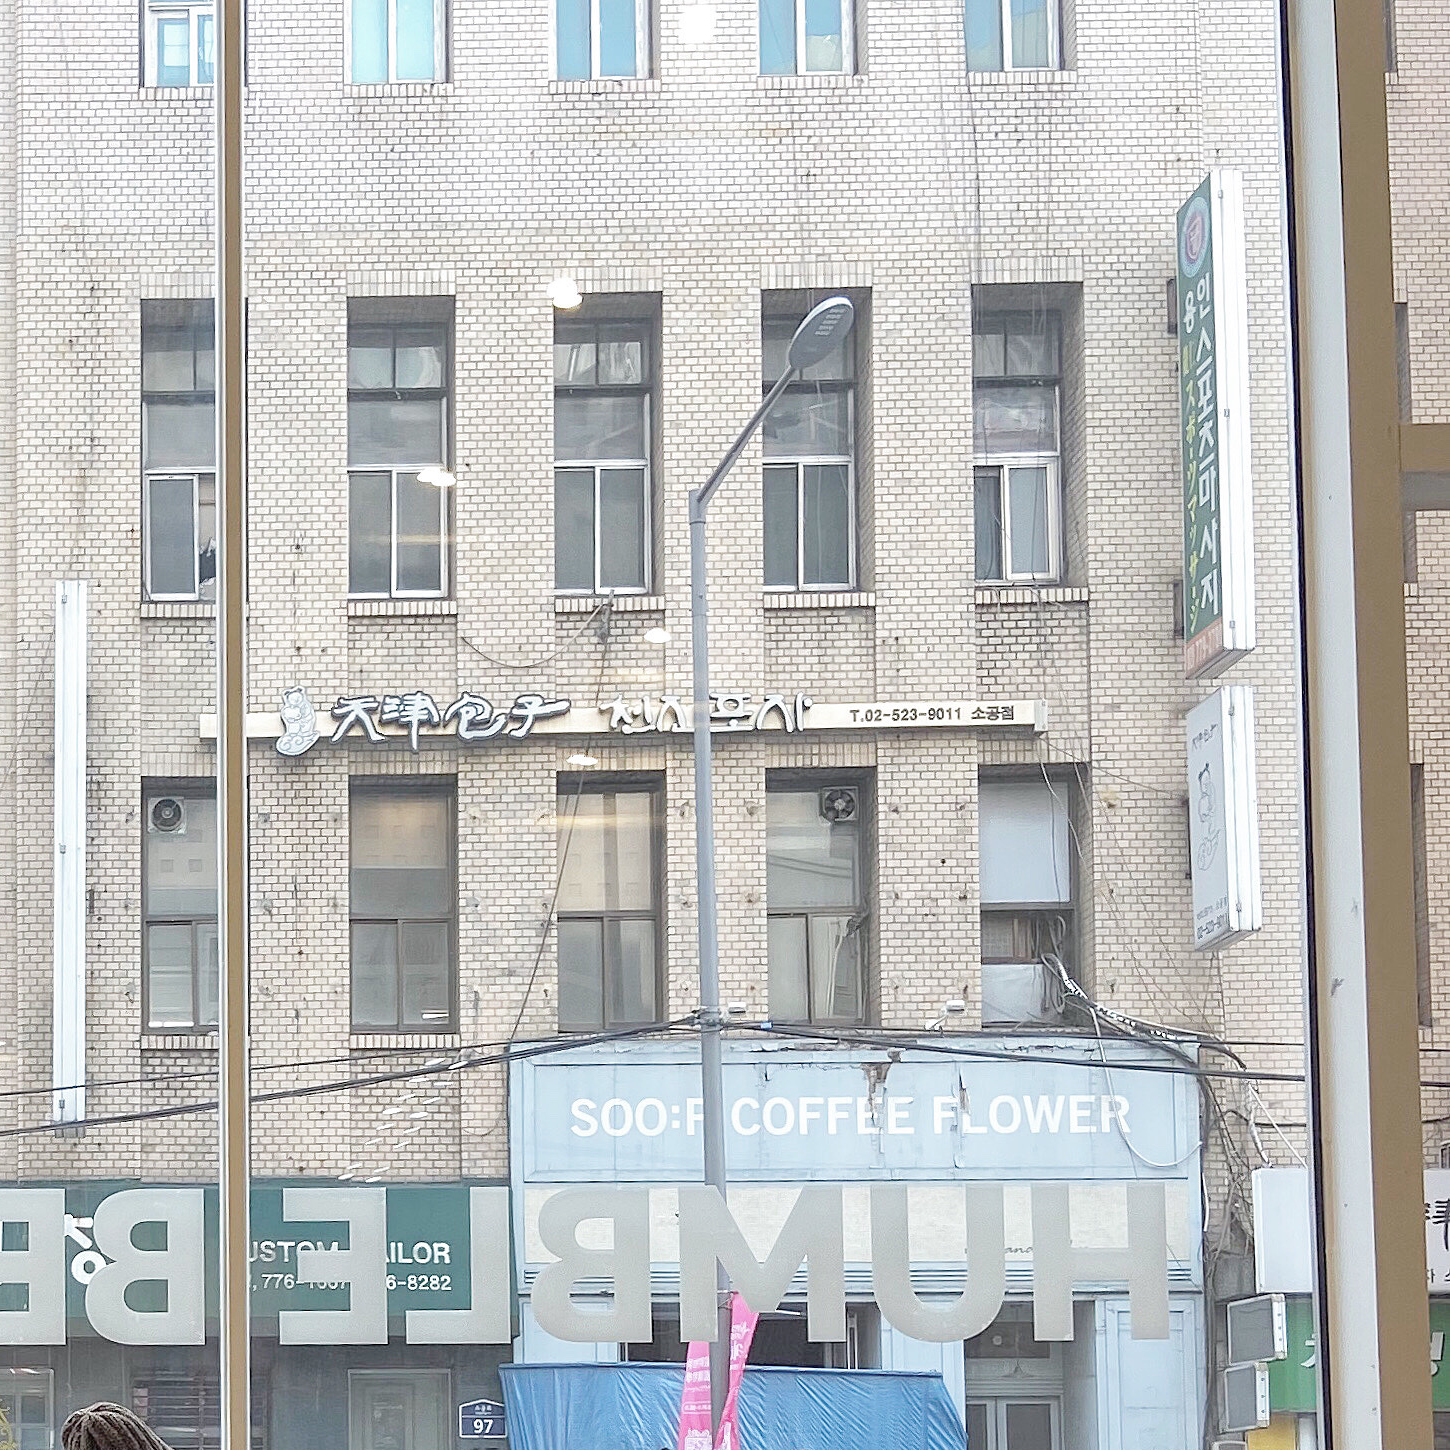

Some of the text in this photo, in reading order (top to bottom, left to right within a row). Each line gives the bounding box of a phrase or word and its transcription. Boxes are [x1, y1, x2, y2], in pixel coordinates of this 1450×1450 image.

[849, 704, 1016, 723] T.02-523-9011 소공점
[730, 1096, 915, 1136] COFFEE
[933, 1094, 1131, 1135] FLOWER
[473, 1419, 494, 1434] 97
